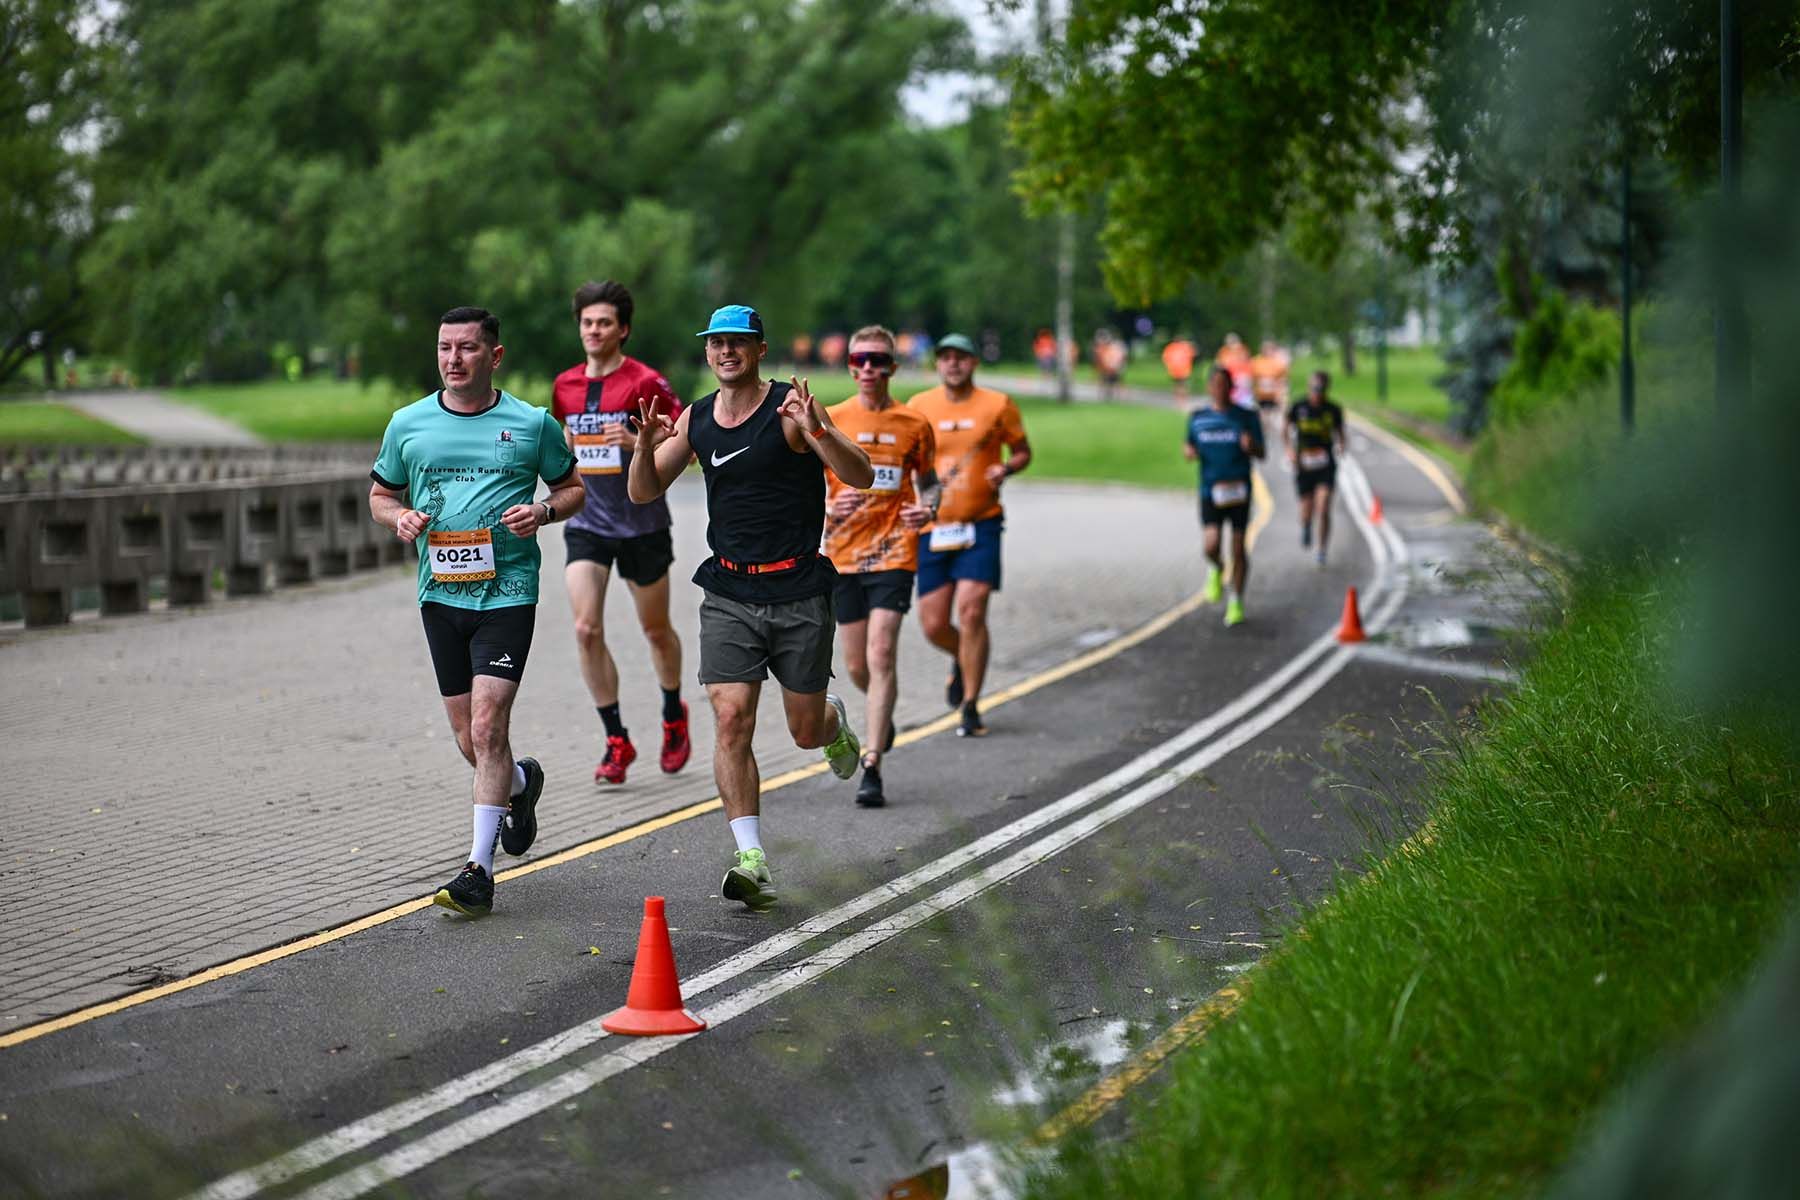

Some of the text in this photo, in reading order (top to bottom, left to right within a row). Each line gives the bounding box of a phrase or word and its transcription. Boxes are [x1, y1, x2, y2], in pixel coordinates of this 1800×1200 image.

[478, 467, 516, 476] Running
[436, 547, 484, 563] 6021
[451, 562, 468, 570] ЮРИЙ
